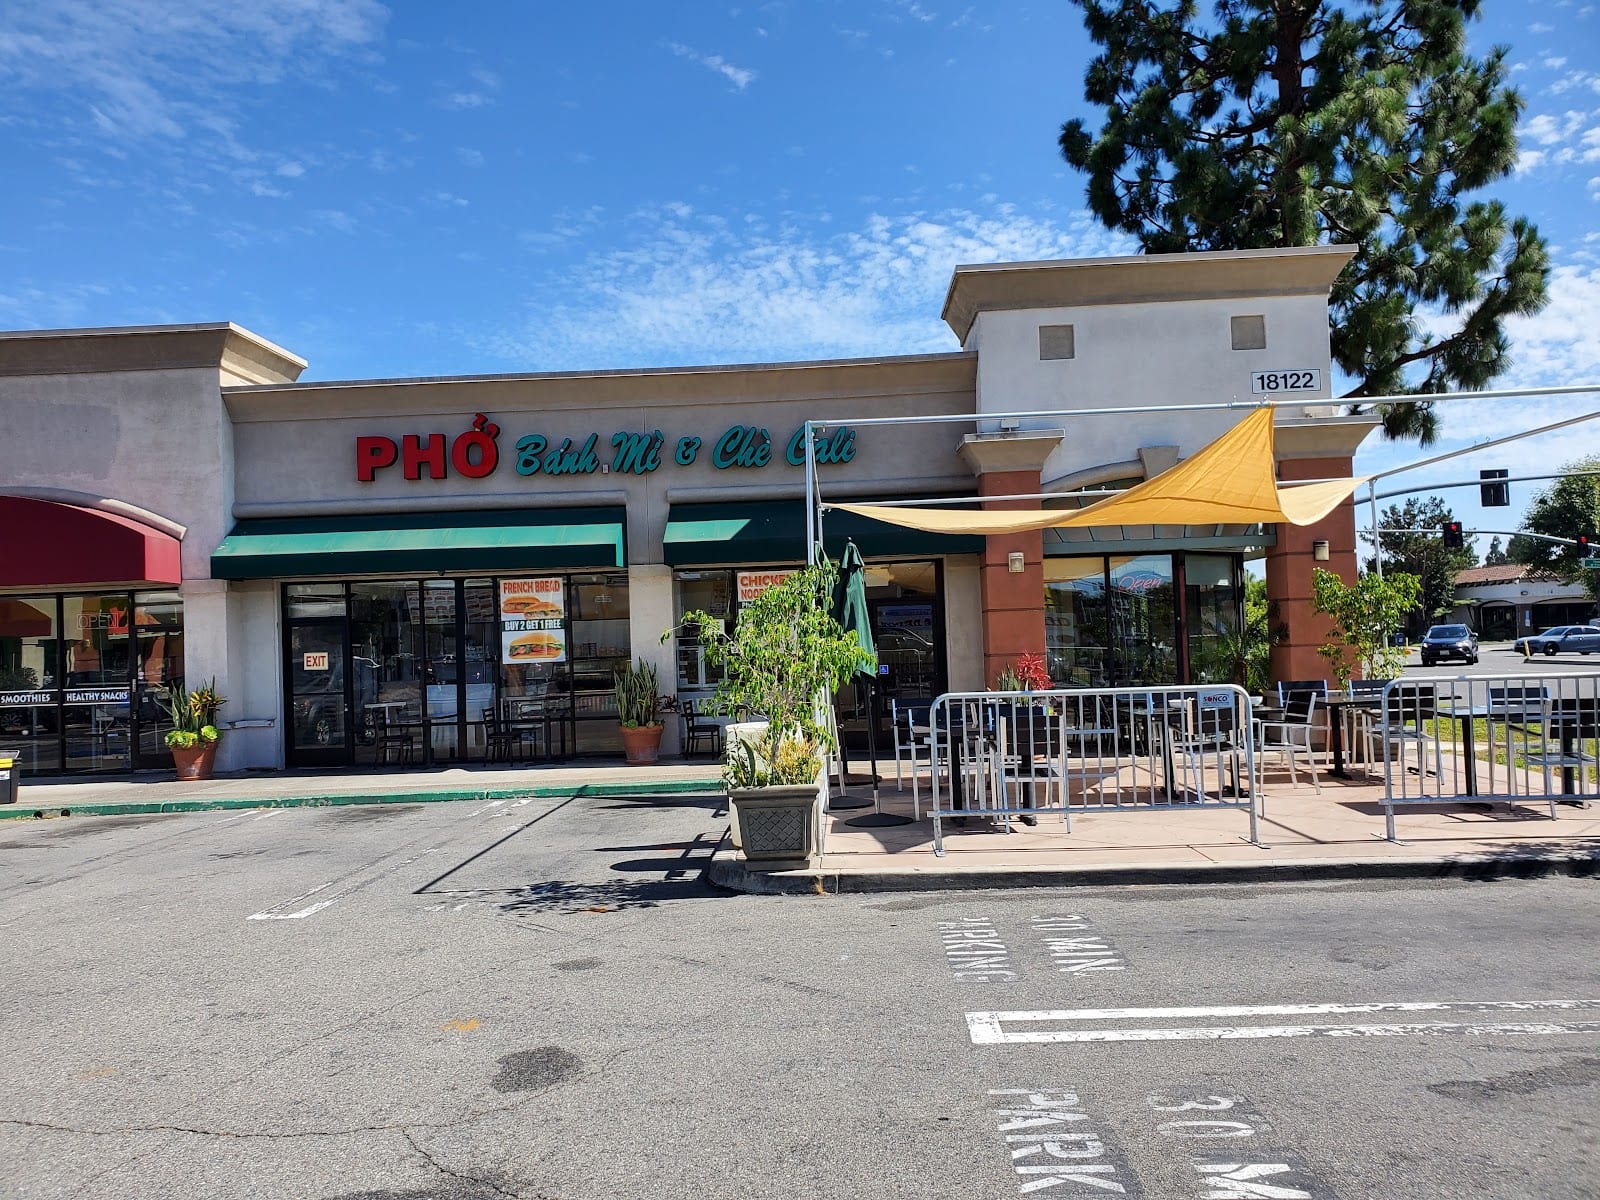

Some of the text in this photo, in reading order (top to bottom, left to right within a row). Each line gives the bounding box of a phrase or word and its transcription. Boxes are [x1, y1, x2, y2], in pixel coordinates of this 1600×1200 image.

[1256, 372, 1315, 391] 18122
[356, 412, 500, 481] PHỞ
[515, 432, 600, 476] Bánh
[675, 436, 701, 466] &
[712, 424, 773, 470] Chè
[785, 425, 857, 467] Cali
[503, 580, 560, 594] FRENCH BREAD
[740, 573, 790, 587] CHICKE
[1119, 576, 1162, 592] Open
[79, 615, 118, 629] OPEN
[505, 619, 561, 631] BUY 2 GET 1 FREE
[306, 655, 327, 667] EXIT
[0, 693, 51, 704] SMOOTHIES
[66, 691, 128, 702] HEALTHY SNACKS
[1203, 695, 1228, 703] SONCO
[1152, 1095, 1256, 1138] 30
[987, 1088, 1126, 1194] PARK
